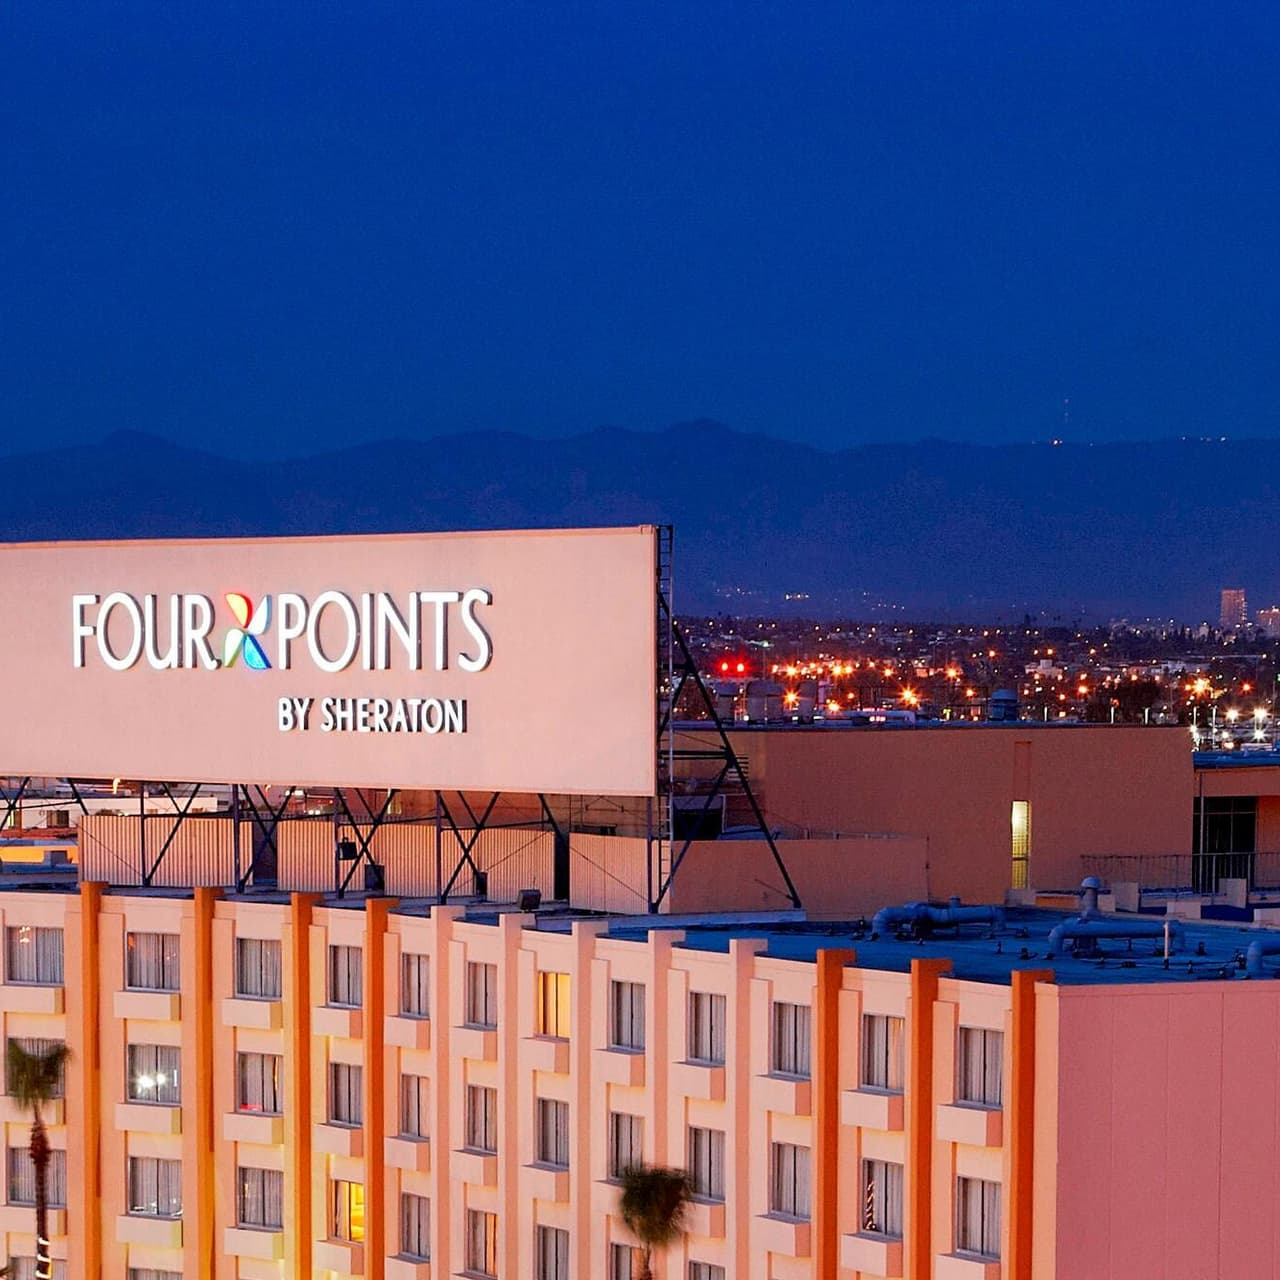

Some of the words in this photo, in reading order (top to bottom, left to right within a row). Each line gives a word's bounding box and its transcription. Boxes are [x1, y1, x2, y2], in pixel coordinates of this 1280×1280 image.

[73, 592, 221, 671] FOUR
[278, 589, 493, 673] POINTS
[278, 697, 311, 732] BY
[320, 698, 467, 734] SHERATON
